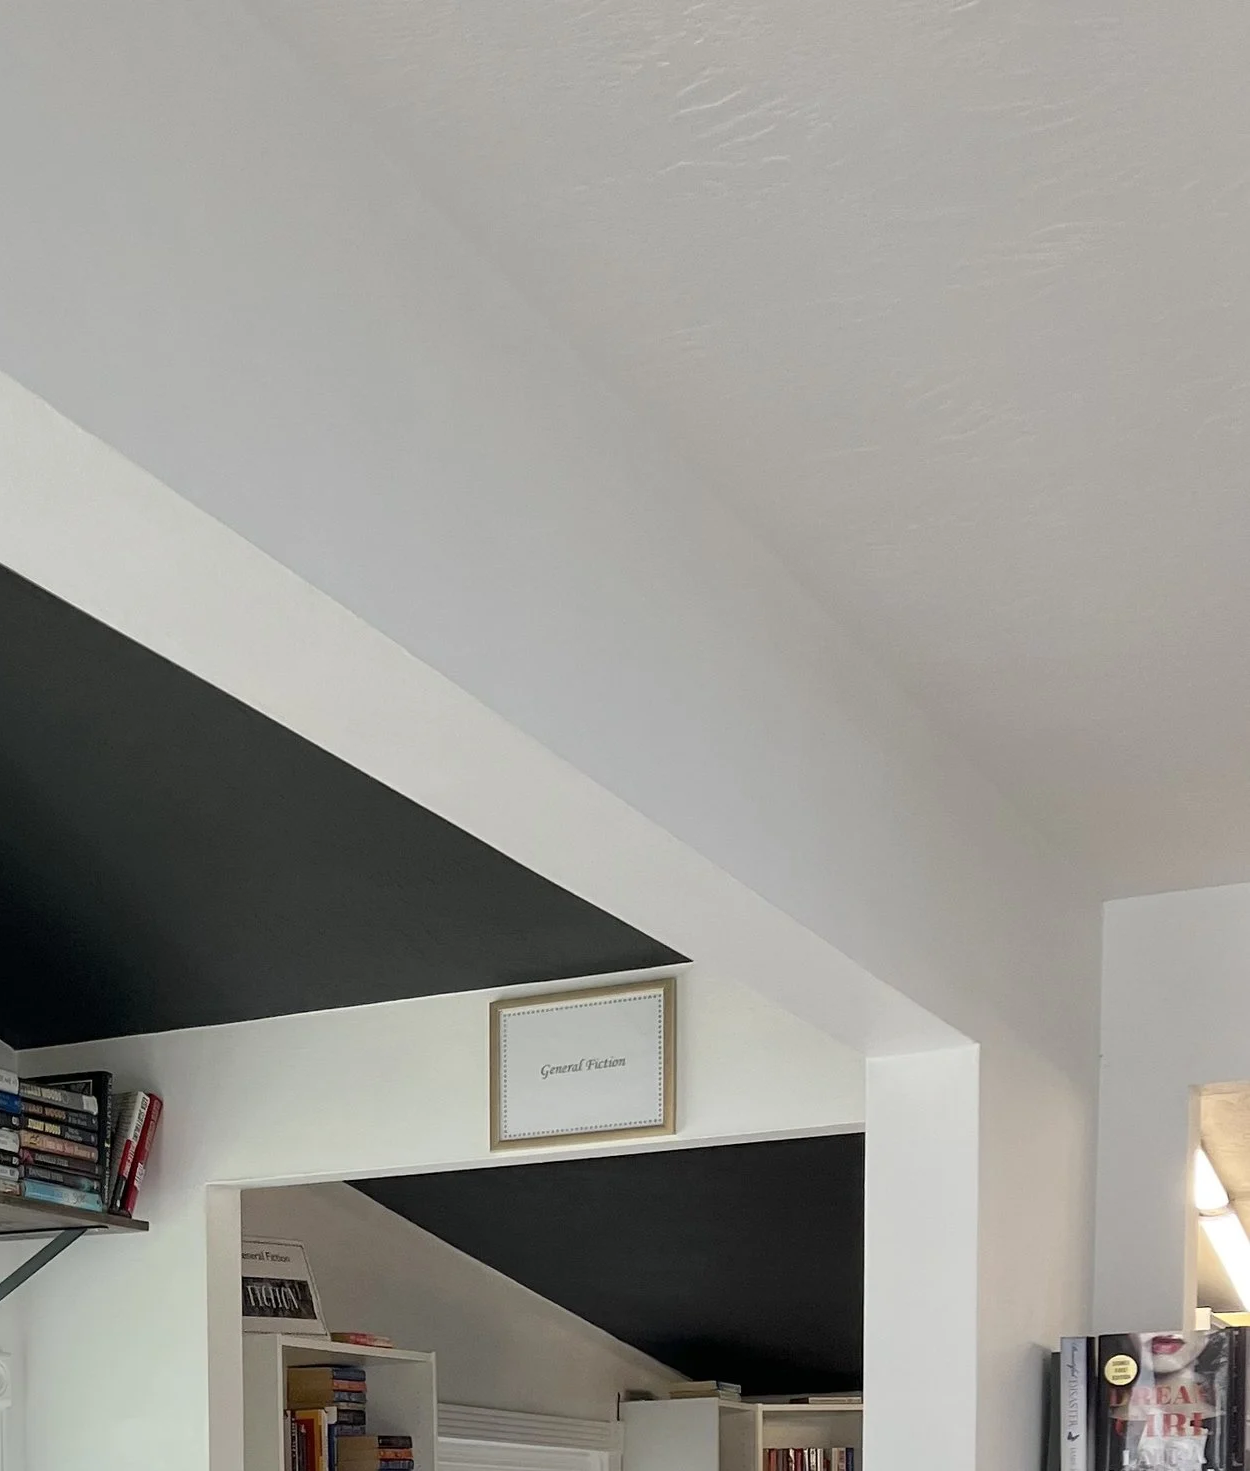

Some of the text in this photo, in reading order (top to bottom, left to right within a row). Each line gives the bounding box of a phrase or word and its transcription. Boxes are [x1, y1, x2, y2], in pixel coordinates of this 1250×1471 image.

[540, 1055, 627, 1079] General Fiction
[241, 1251, 291, 1264] eneral Fiction
[246, 1283, 300, 1311] FICTION
[1068, 1380, 1079, 1428] DISASTER
